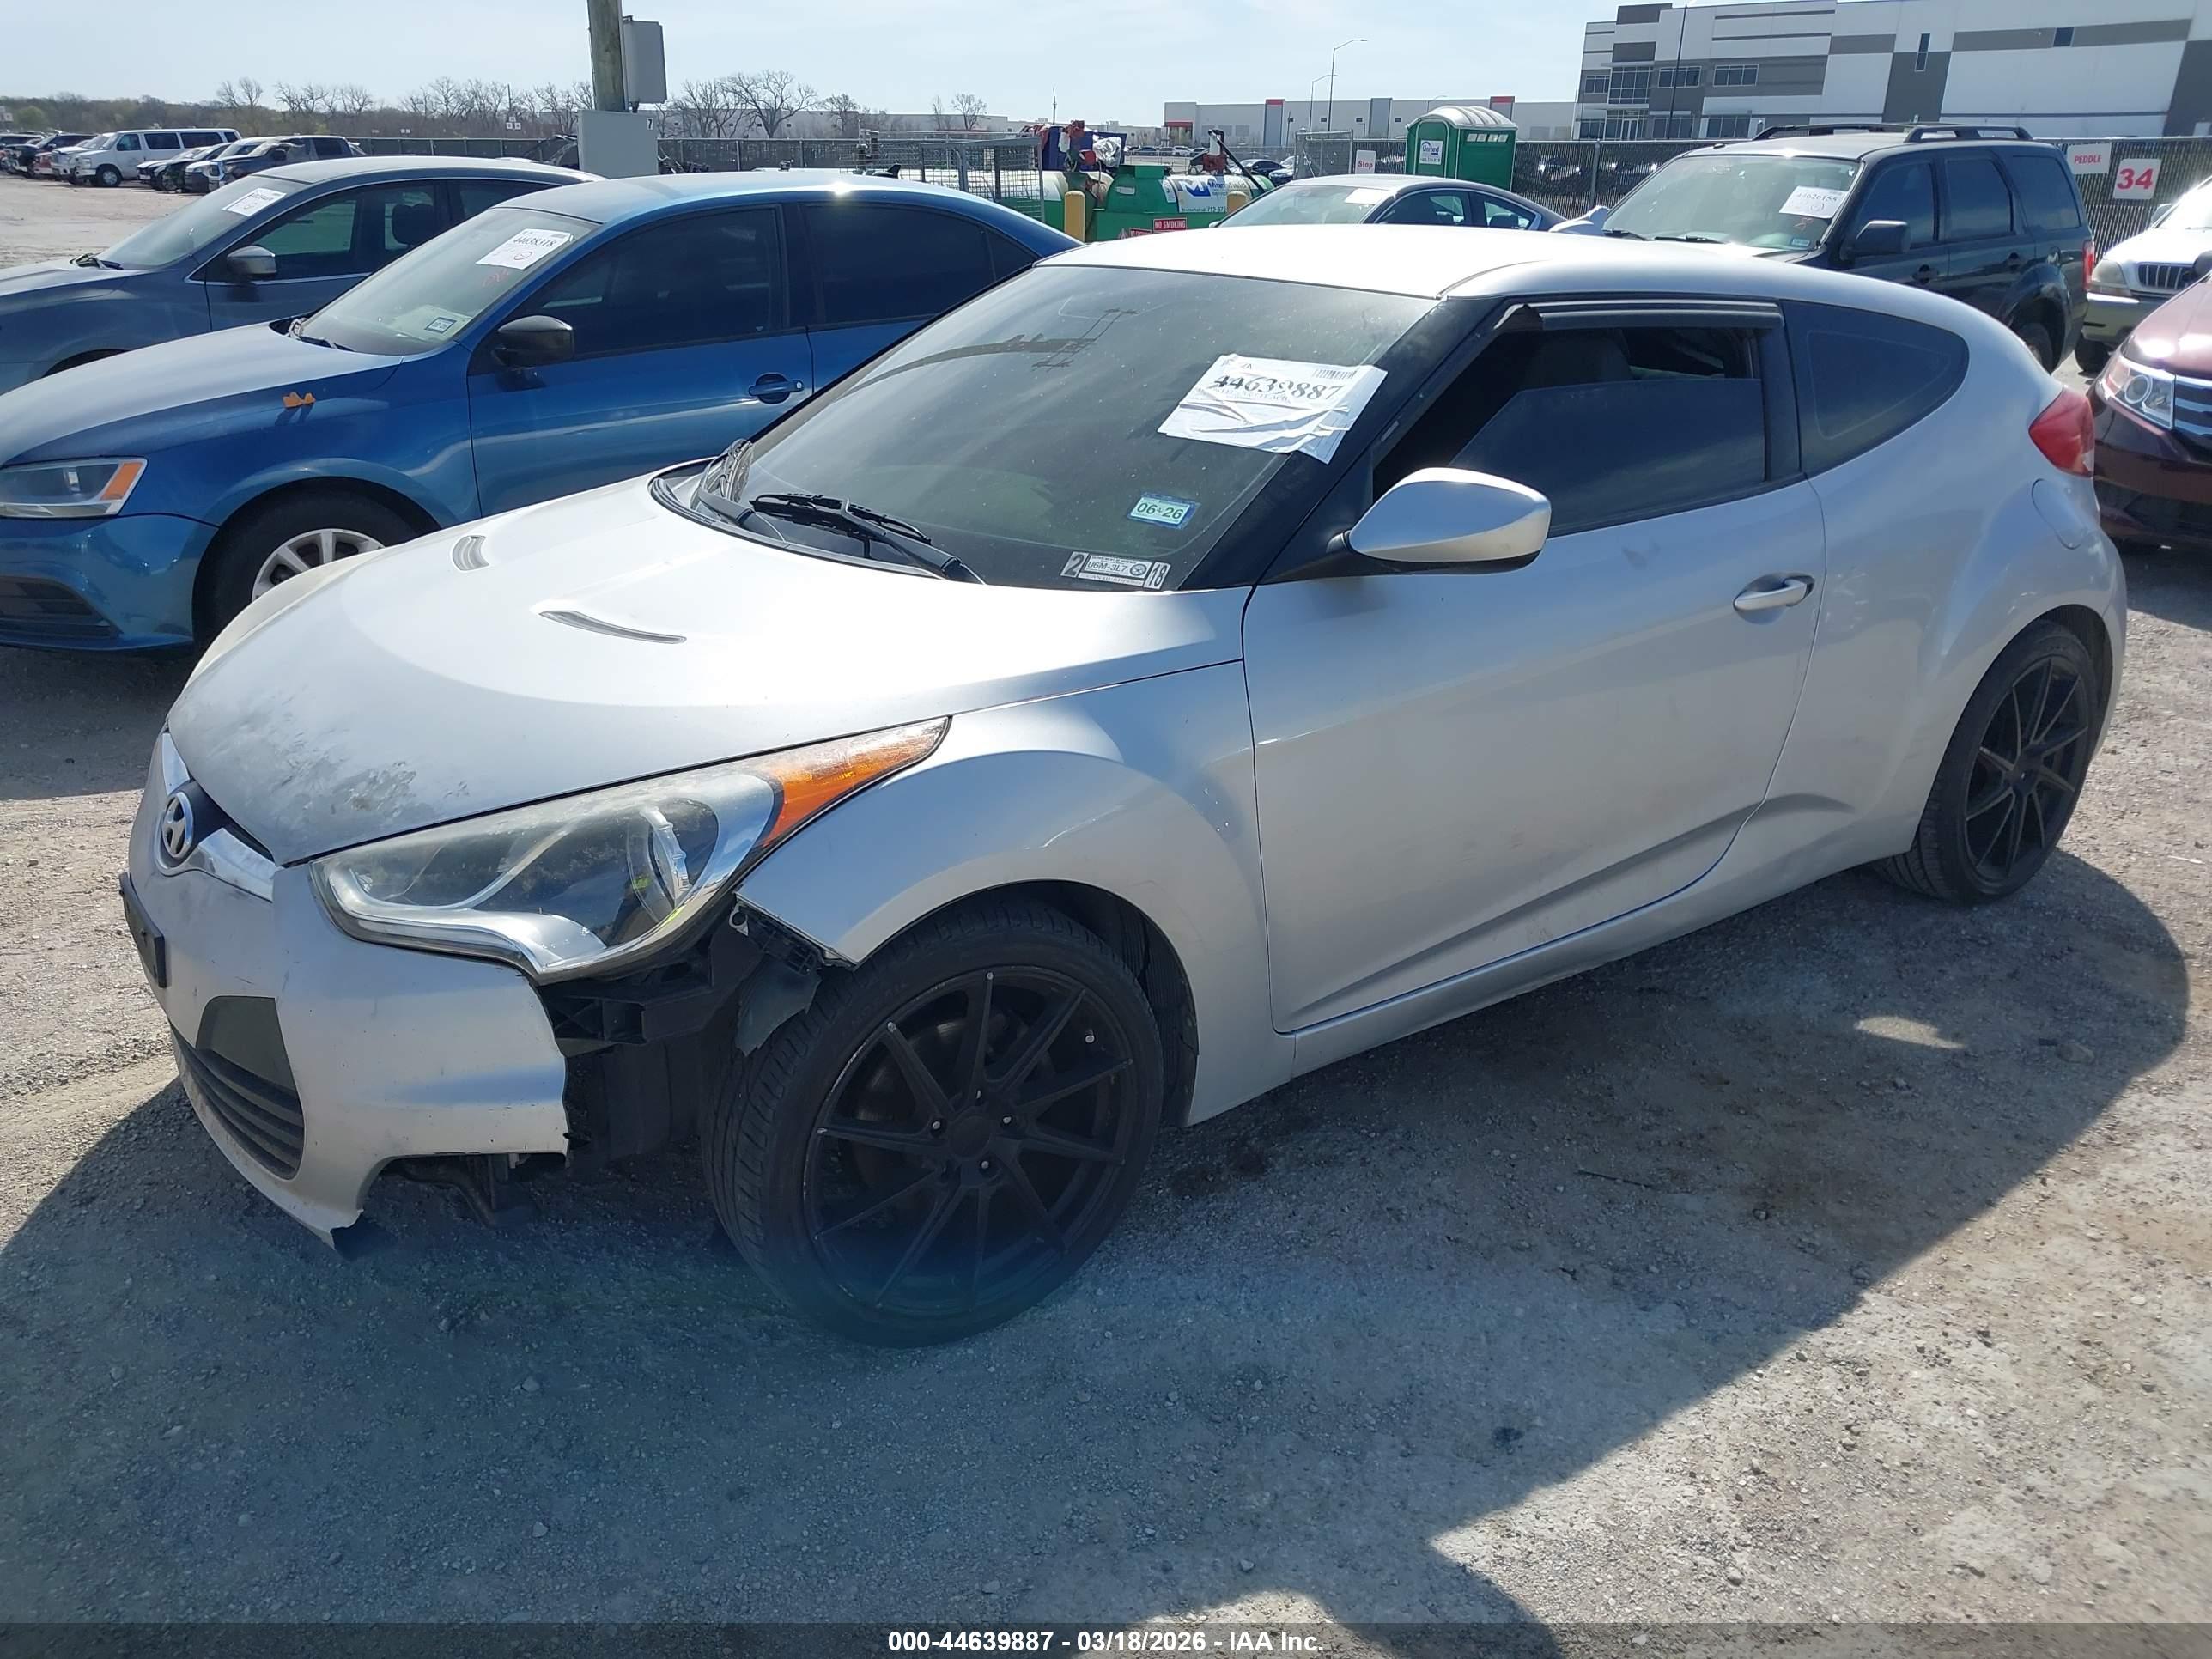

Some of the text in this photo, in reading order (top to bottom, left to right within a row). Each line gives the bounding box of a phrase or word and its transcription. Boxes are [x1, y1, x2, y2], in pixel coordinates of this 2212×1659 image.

[1358, 161, 1373, 170] Stop
[2074, 155, 2101, 164] PEDDLE
[2117, 168, 2154, 190] 34
[1164, 220, 1186, 228] SMOKING
[1213, 375, 1346, 400] 44639887
[1065, 554, 1085, 576] 2
[1147, 563, 1168, 587] 18
